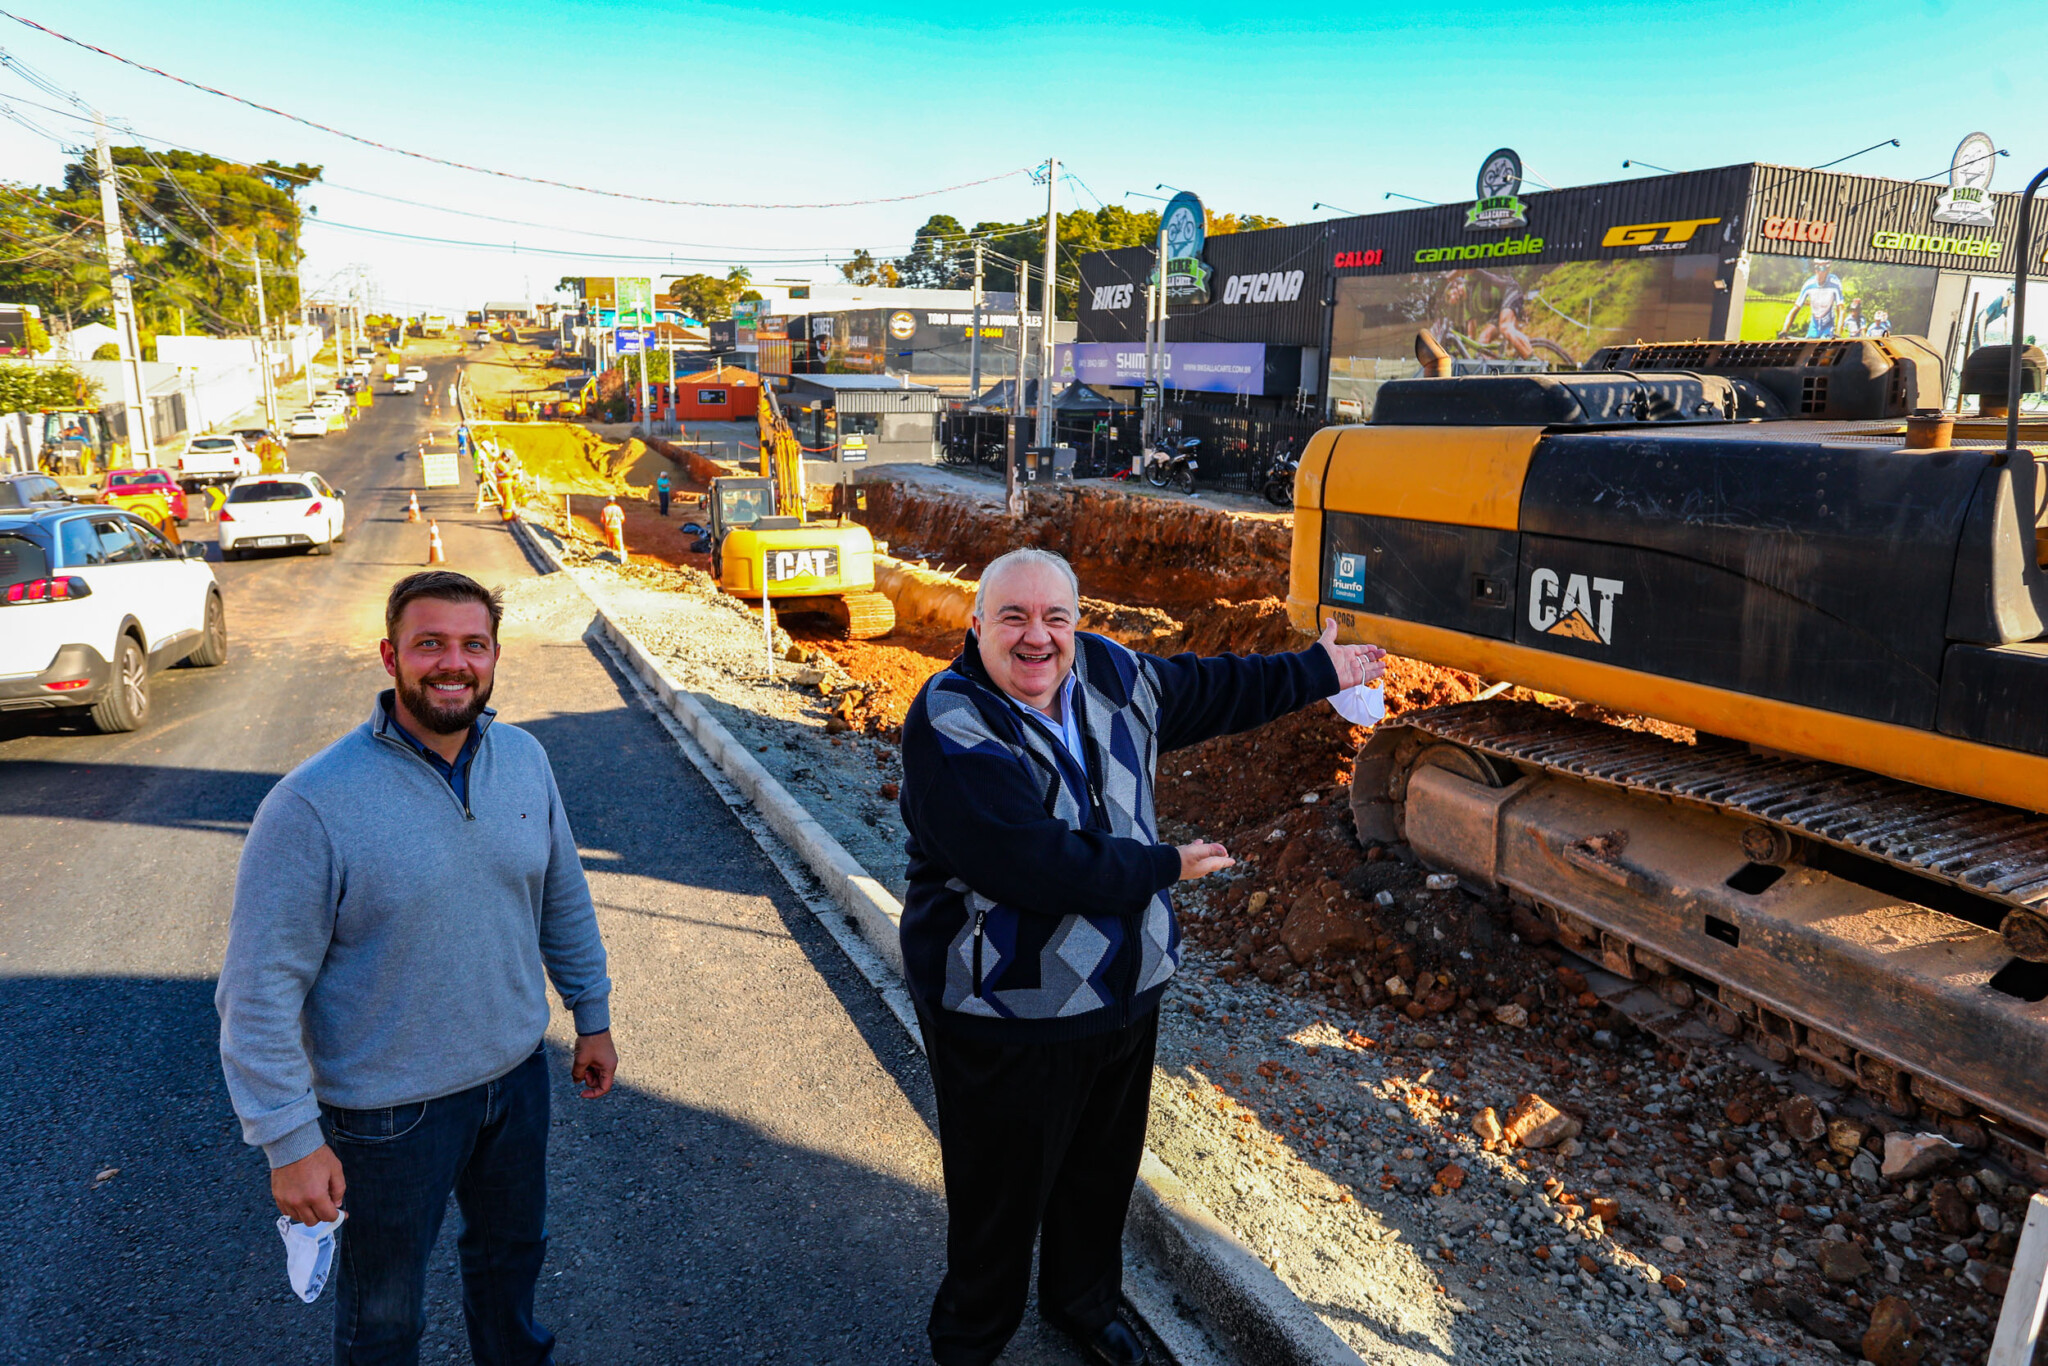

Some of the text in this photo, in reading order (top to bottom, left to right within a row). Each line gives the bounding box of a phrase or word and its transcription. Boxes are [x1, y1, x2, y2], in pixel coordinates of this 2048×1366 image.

[1481, 197, 1512, 211] BIKE
[1601, 217, 1722, 247] GT
[1763, 215, 1836, 243] CALOI
[1334, 249, 1383, 268] CALOI
[1414, 234, 1544, 263] cannondale
[1638, 242, 1688, 252] BICYCLES
[1872, 231, 2003, 259] cannondale
[1091, 283, 1134, 311] BIKES
[1222, 269, 1305, 305] OFICINA
[1116, 353, 1171, 370] SHIMO
[775, 550, 830, 581] CAT
[1333, 578, 1363, 592] Triunfo
[1528, 567, 1624, 645] CAT
